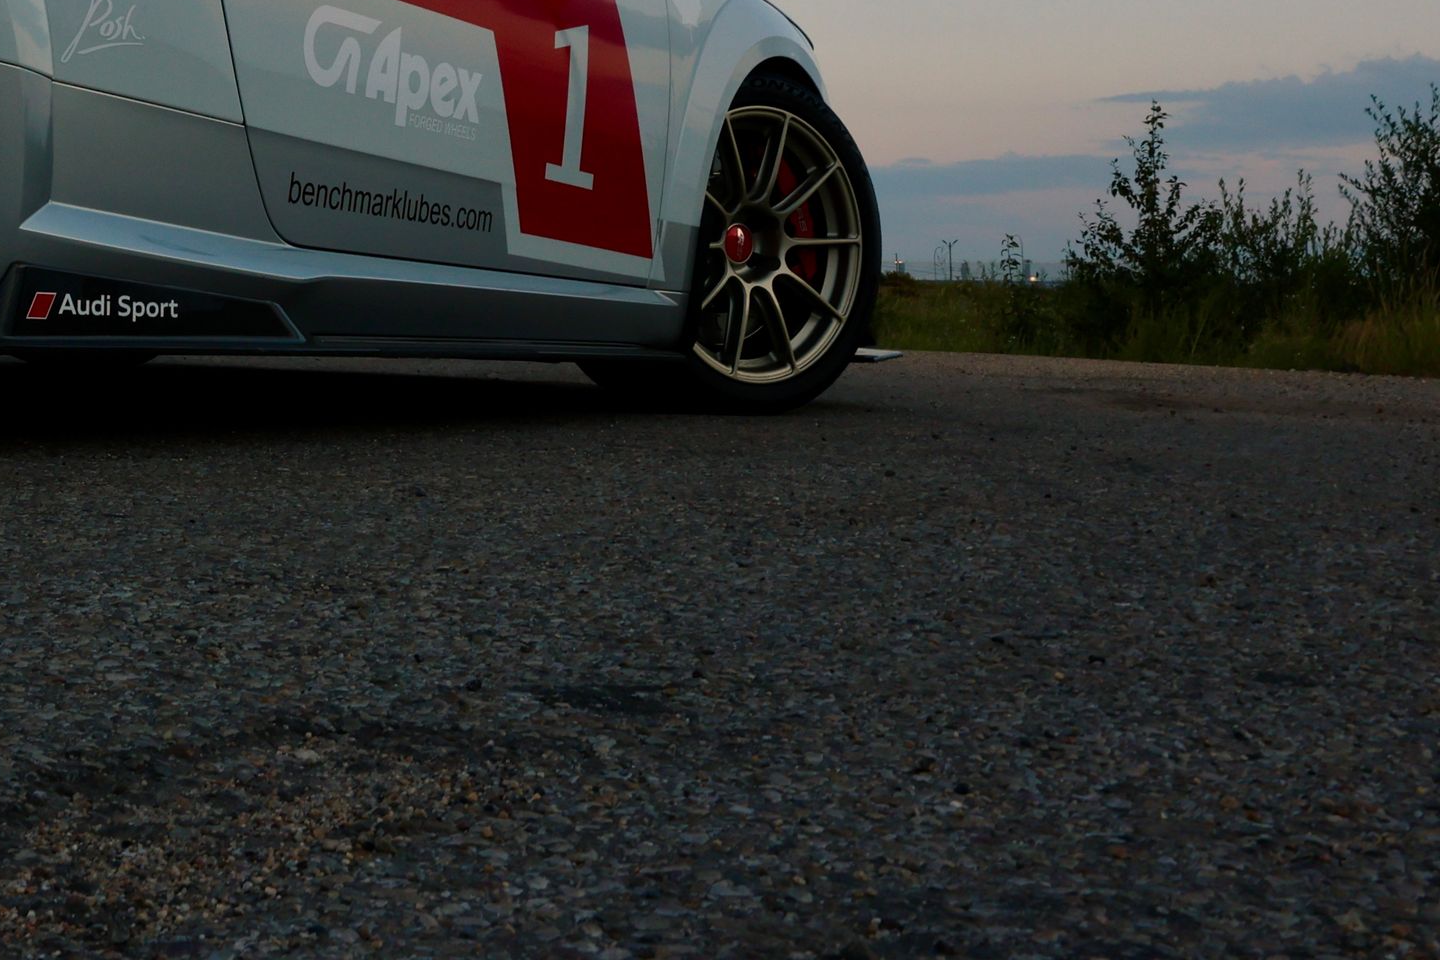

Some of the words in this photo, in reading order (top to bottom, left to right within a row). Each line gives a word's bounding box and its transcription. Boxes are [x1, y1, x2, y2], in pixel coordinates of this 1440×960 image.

[545, 24, 594, 190] 1
[288, 170, 493, 232] benchmarklubes.com
[58, 296, 111, 316] Audi
[117, 296, 179, 322] Sport
